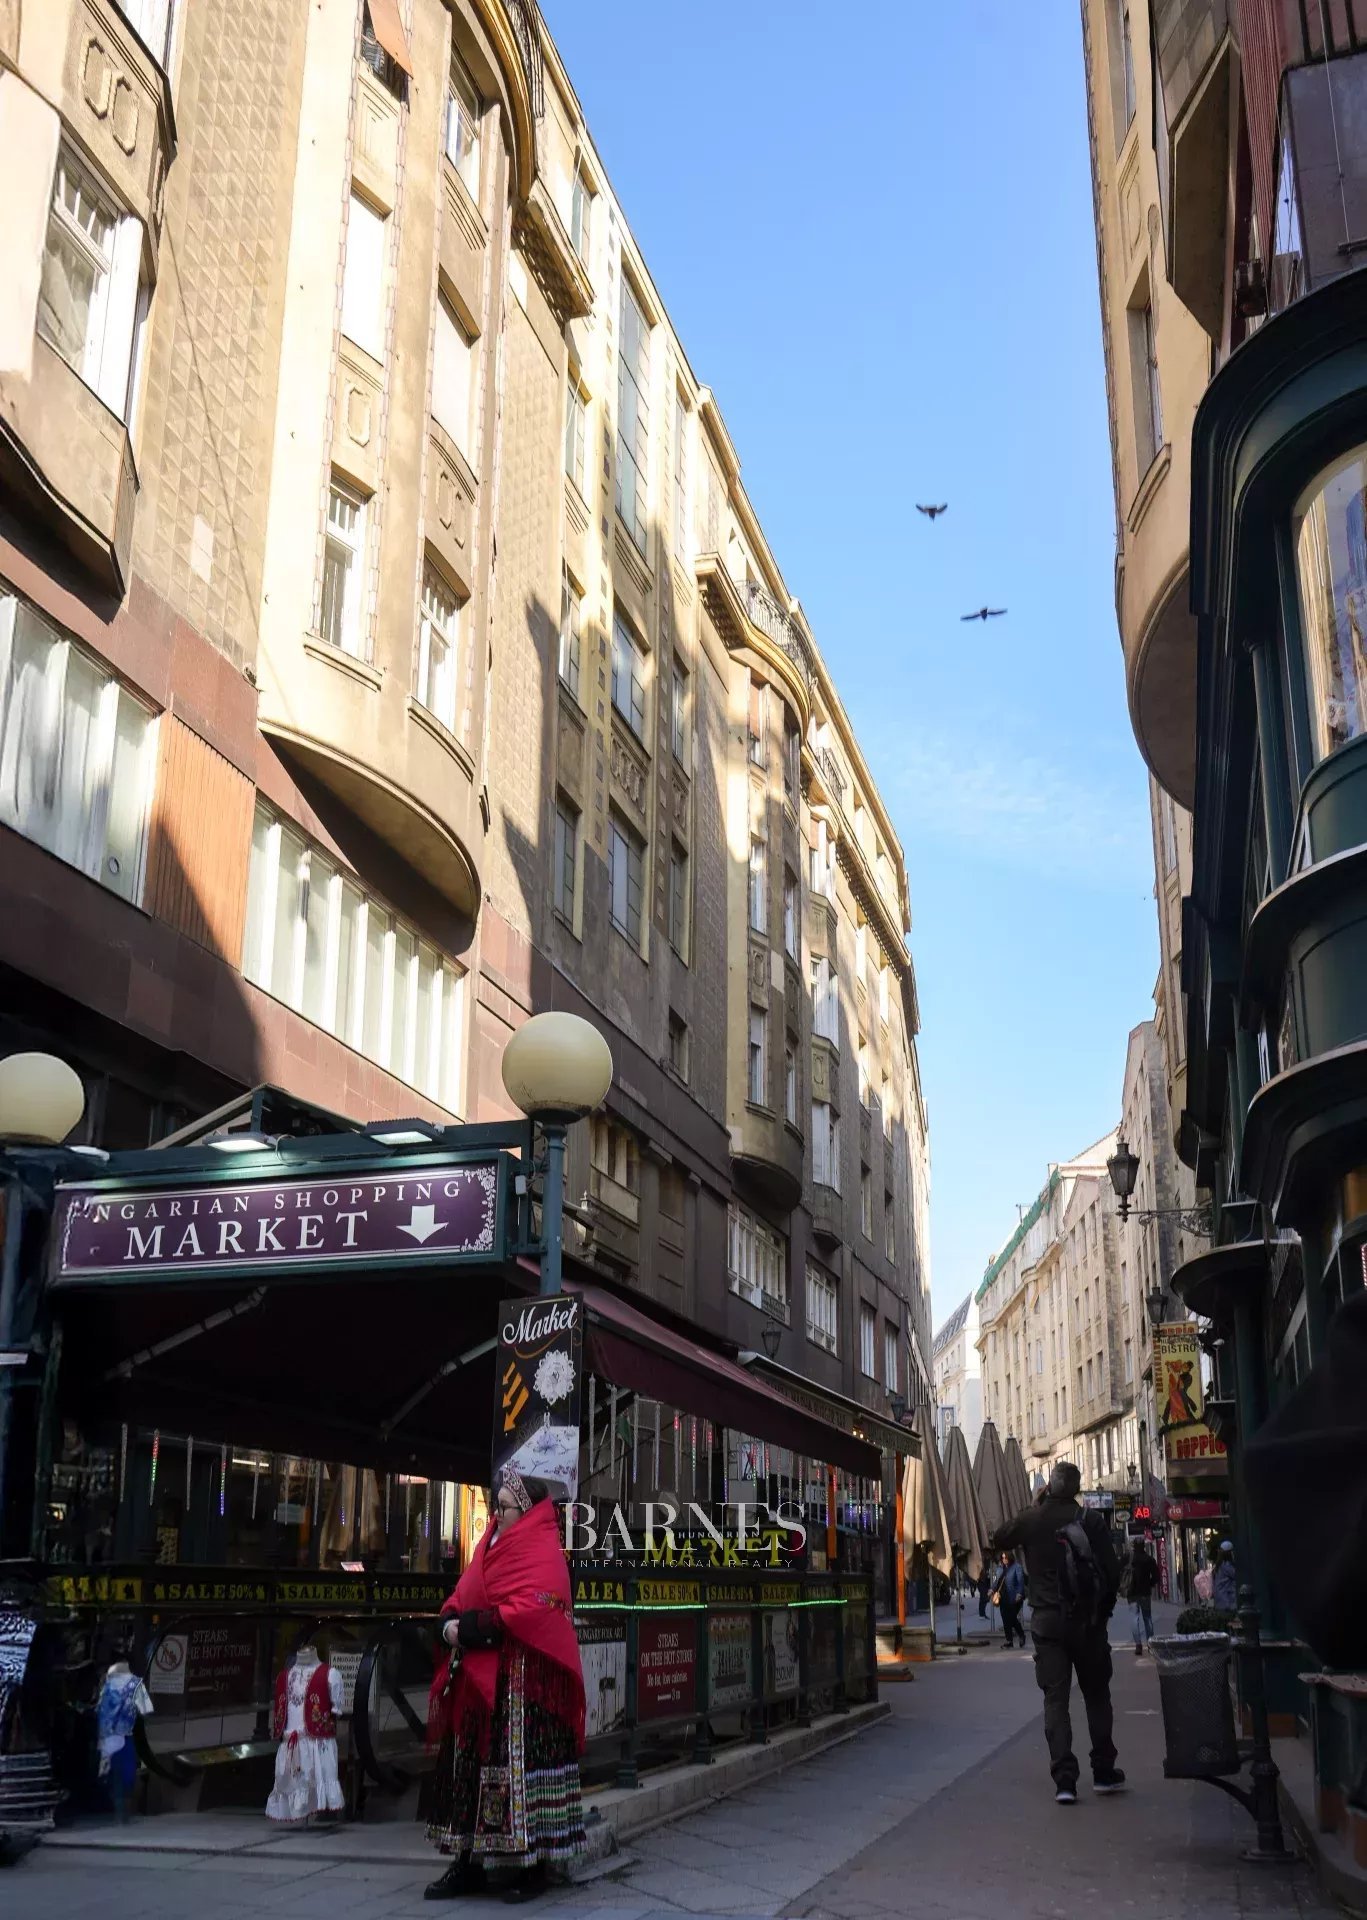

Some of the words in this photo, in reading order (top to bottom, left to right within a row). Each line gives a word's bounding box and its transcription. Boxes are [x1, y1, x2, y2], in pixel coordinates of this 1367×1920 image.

[94, 1196, 250, 1222] NGARIAN
[274, 1180, 461, 1209] SHOPPING
[123, 1210, 369, 1260] MARKET
[502, 1302, 578, 1345] Market
[1161, 1343, 1196, 1354] BISTRO
[1169, 1505, 1182, 1515] ria
[643, 1529, 788, 1567] MARKET
[168, 1583, 227, 1600] SALE
[229, 1584, 254, 1600] 50%
[288, 1585, 333, 1600] SALE
[382, 1586, 419, 1600] SALE
[575, 1580, 614, 1601] ALE
[643, 1583, 677, 1599] SALE
[657, 1632, 679, 1648] STEAKS
[640, 1652, 650, 1668] ON
[651, 1651, 663, 1666] THE
[663, 1650, 675, 1665] HOT
